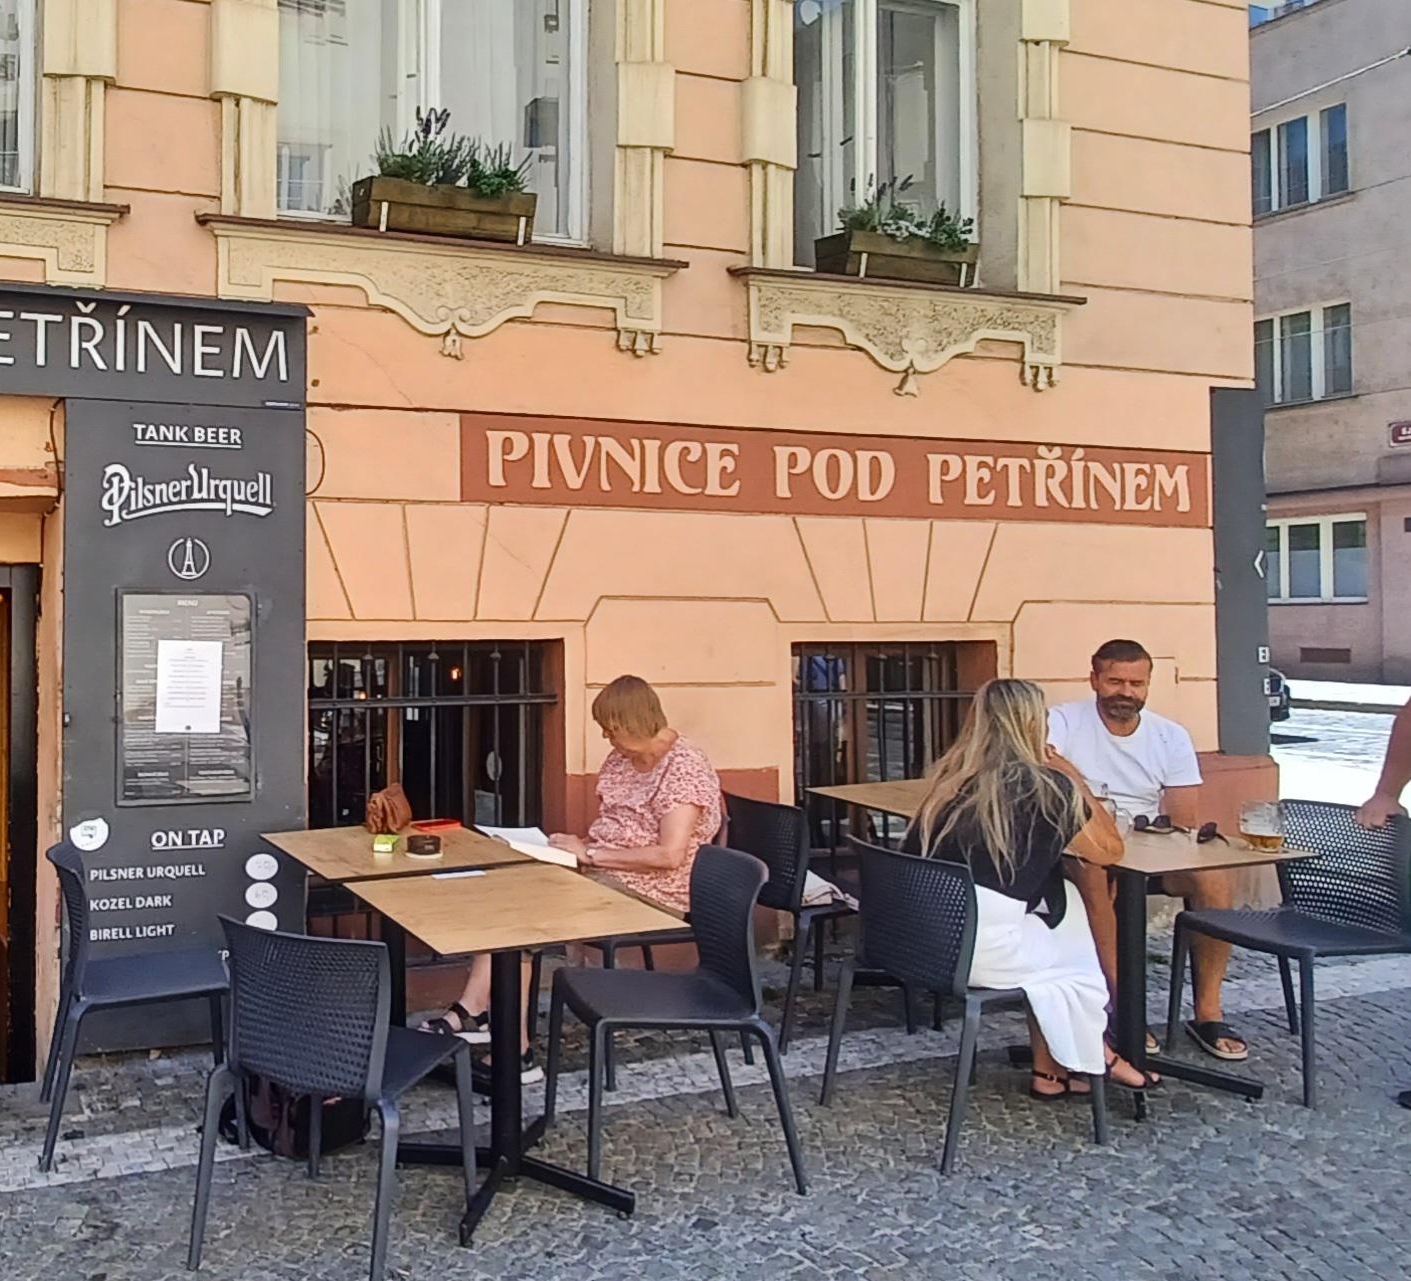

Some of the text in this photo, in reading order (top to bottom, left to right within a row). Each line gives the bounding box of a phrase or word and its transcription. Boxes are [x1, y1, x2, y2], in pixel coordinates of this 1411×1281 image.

[132, 423, 242, 444] TANK BEER
[485, 429, 1192, 513] PIVNICE POD PETŘÍNEM
[101, 463, 272, 527] Pilsner Urquell
[151, 829, 225, 847] ON TAP
[90, 864, 206, 881] PILSNER URQUELL
[90, 895, 172, 911] KOZEL DARK
[90, 924, 175, 941] BIRELL LIGHT
